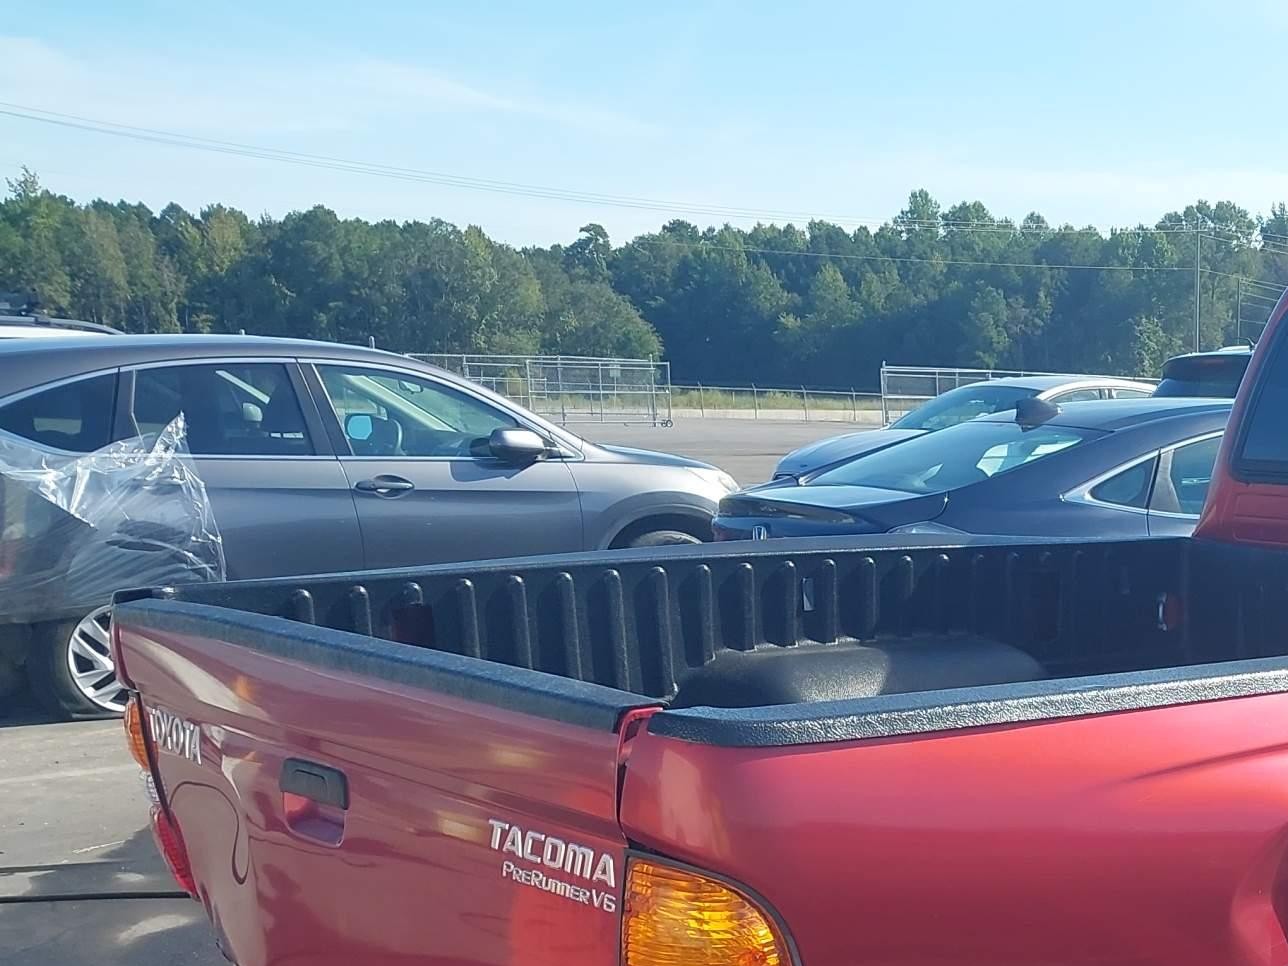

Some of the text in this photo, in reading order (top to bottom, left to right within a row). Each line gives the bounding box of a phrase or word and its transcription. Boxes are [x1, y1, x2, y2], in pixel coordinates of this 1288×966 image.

[145, 707, 202, 765] TOYOTA
[488, 819, 616, 889] TACOMA
[591, 889, 617, 913] V6
